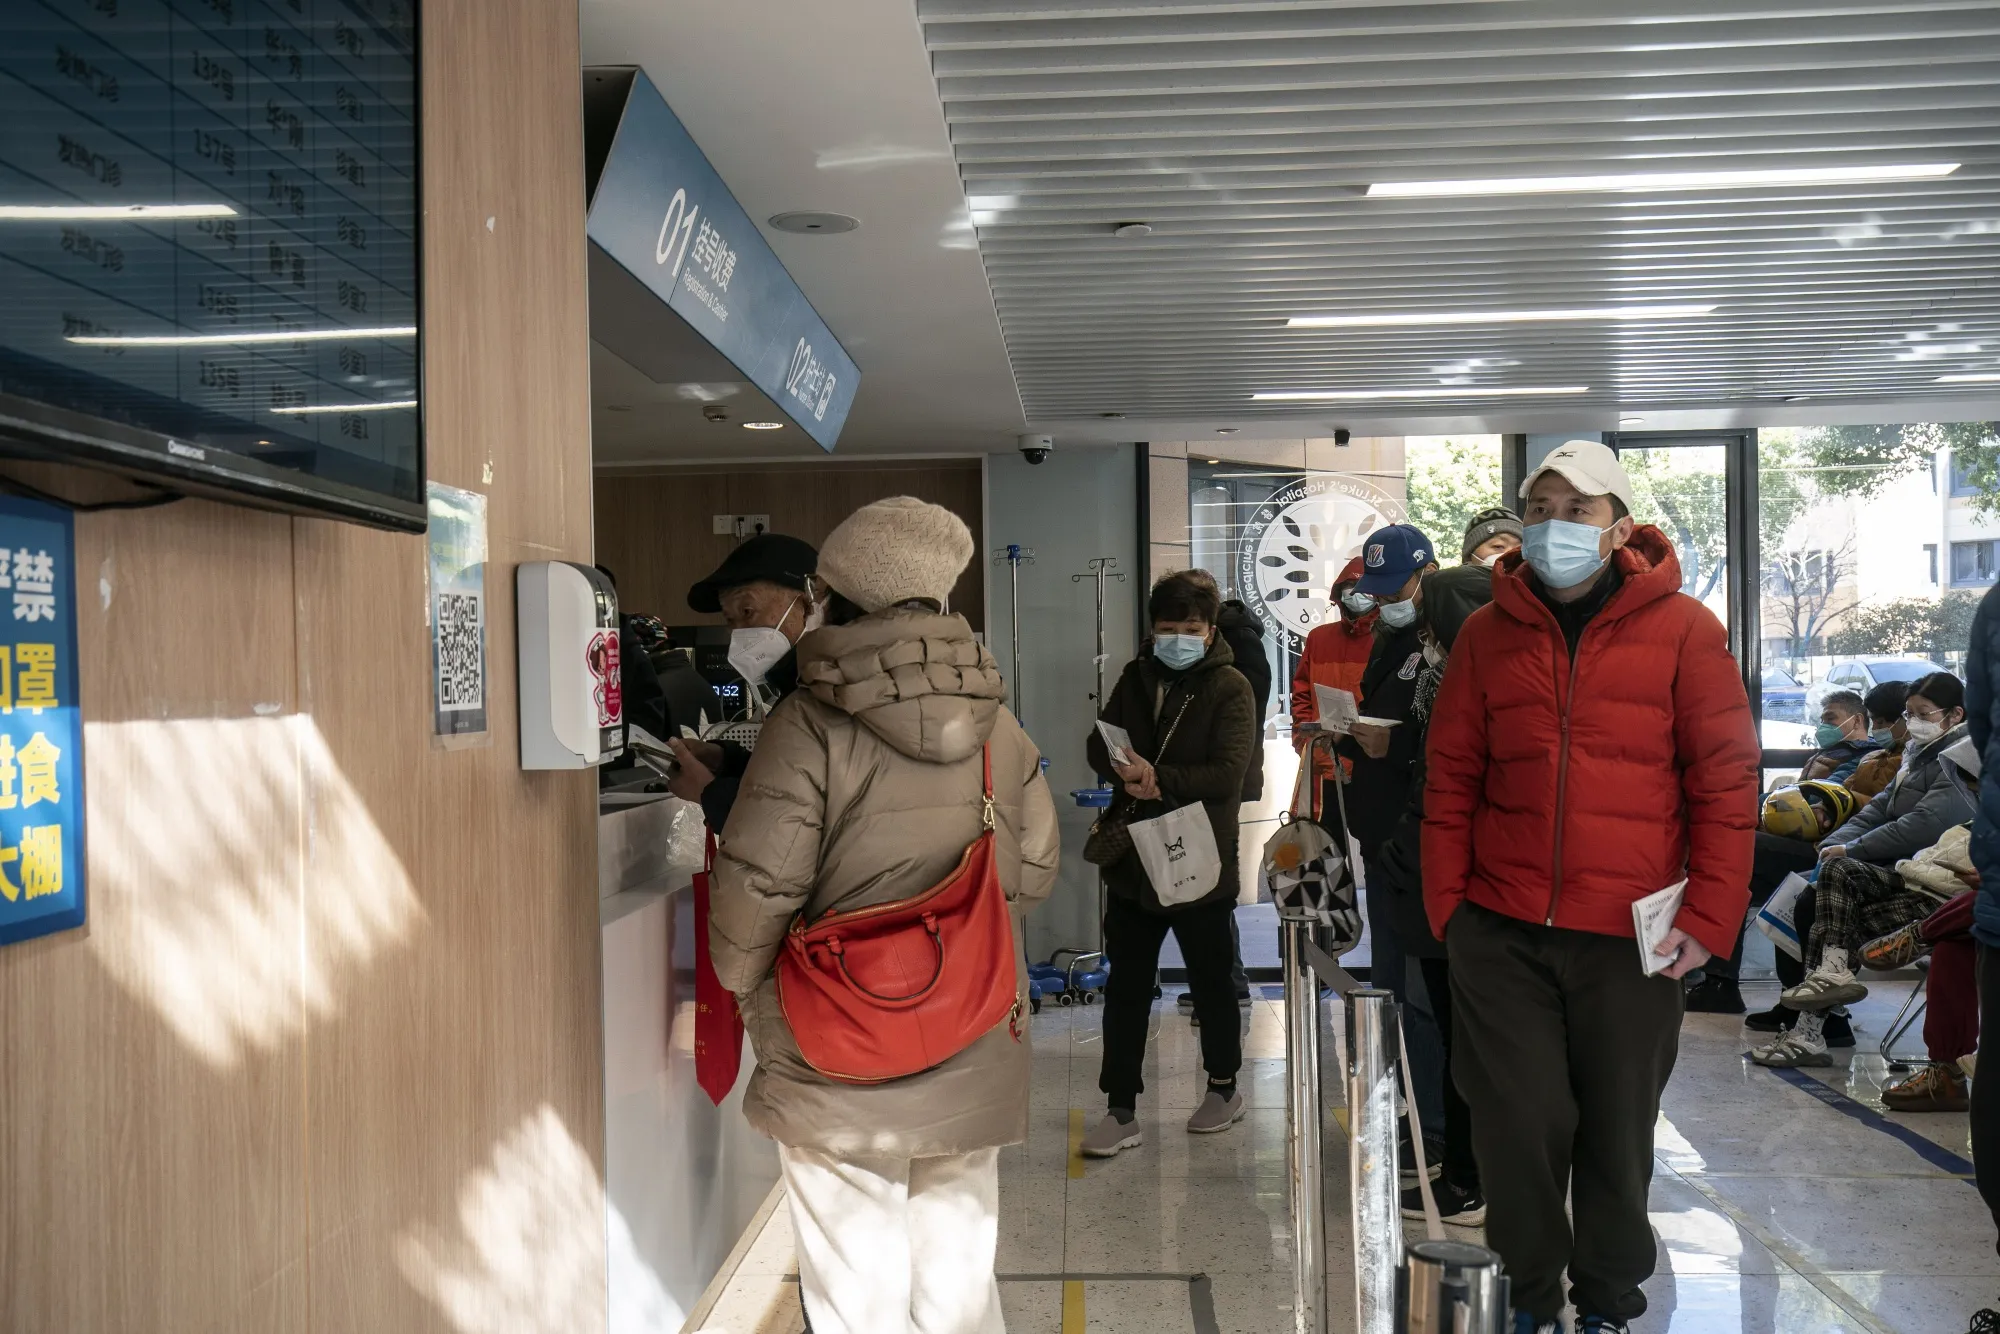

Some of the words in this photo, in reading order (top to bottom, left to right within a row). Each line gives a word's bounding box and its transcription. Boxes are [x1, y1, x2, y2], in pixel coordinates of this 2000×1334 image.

[193, 128, 237, 176] 137号
[656, 187, 699, 278] 01
[692, 216, 736, 293] 挂号收费
[683, 267, 708, 305] Registration
[707, 292, 714, 309] &
[712, 297, 729, 322] Cashier
[786, 337, 811, 397] 02
